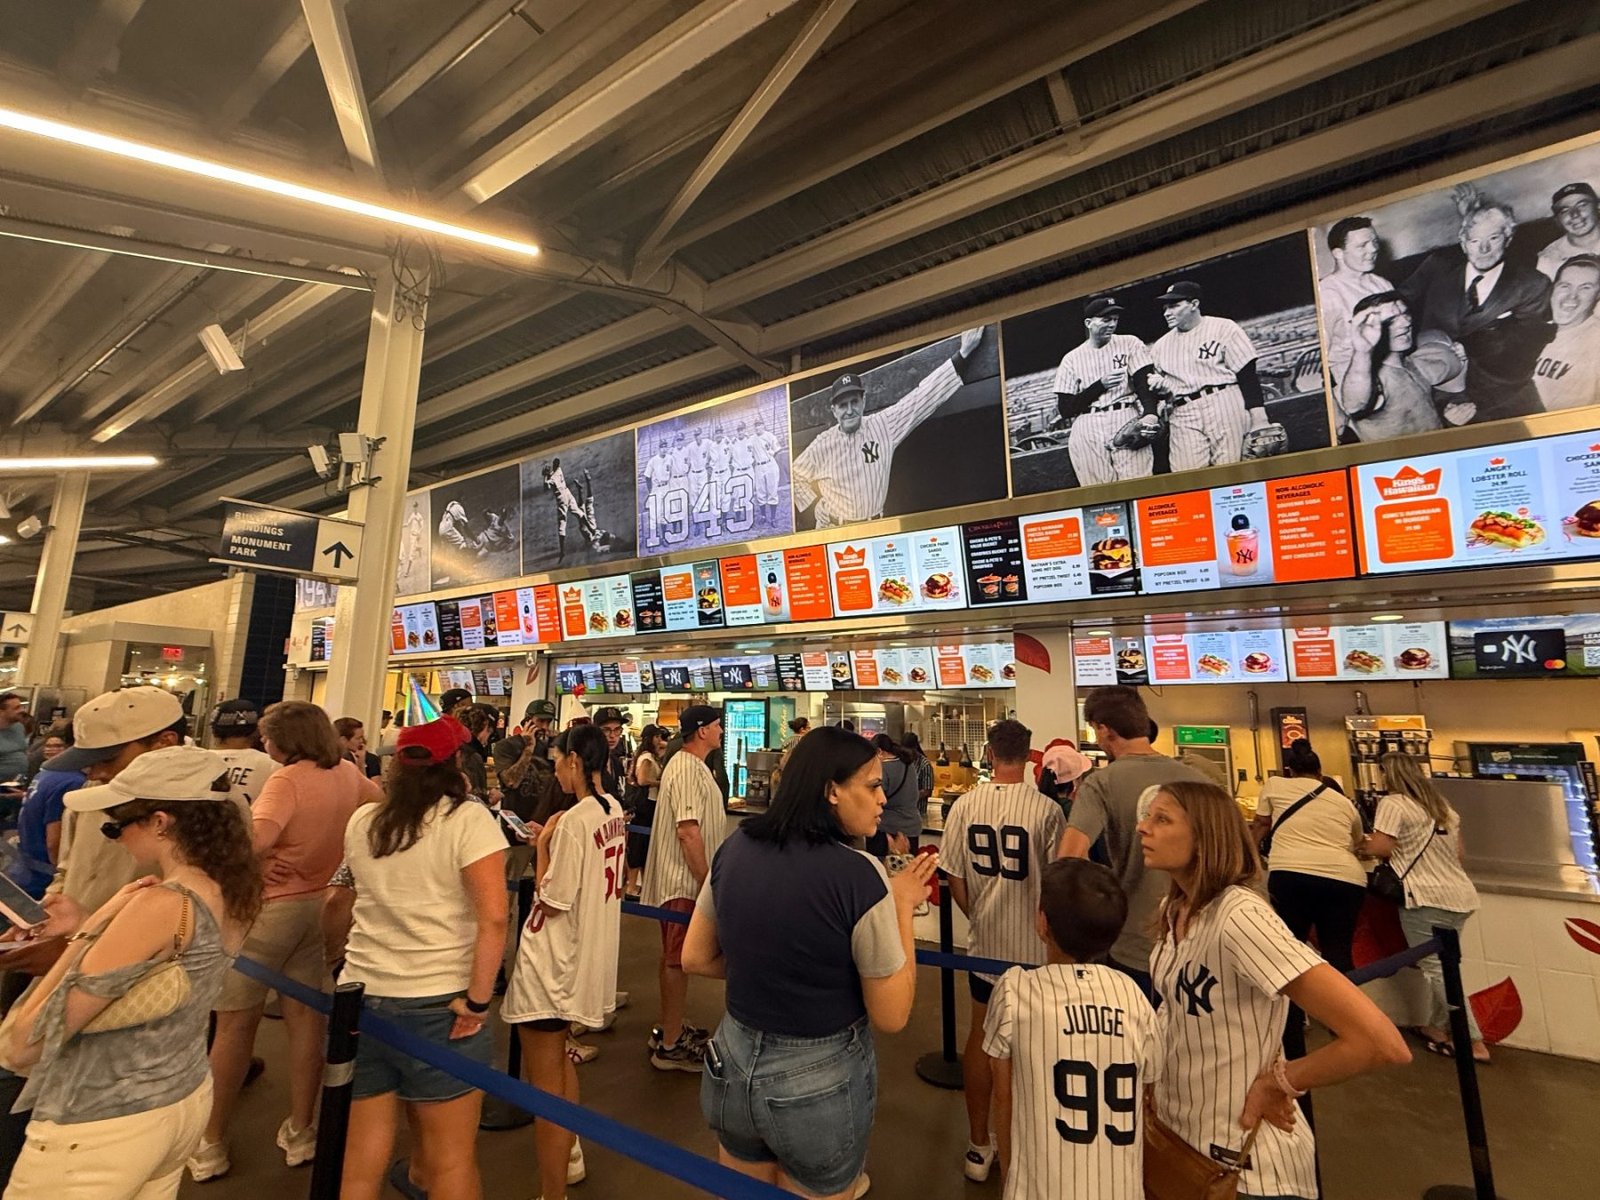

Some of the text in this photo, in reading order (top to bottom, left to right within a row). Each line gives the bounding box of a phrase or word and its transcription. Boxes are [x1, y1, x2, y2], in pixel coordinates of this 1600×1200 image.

[1535, 357, 1574, 380] ORK
[862, 441, 880, 464] NY
[1471, 470, 1528, 482] LOBSTER ROLL
[1484, 464, 1512, 473] ANGRY
[1275, 481, 1325, 493] NON-ALCOHOLIC
[1383, 483, 1436, 496] Hawaiian
[1392, 476, 1425, 488] King's
[1275, 490, 1312, 500] BEVERAGES
[644, 474, 754, 549] 1943
[1147, 502, 1176, 511] ALCOHOLIC
[1148, 508, 1178, 517] BEVERAGES
[230, 534, 293, 551] MONUMENT
[229, 545, 258, 558] PARK
[1501, 634, 1538, 664] NY
[729, 667, 743, 684] NY
[226, 767, 253, 786] GE
[967, 824, 1029, 881] 99
[1175, 960, 1219, 1017] NY
[1063, 1004, 1125, 1038] JUDGE
[1053, 1059, 1138, 1146] 99
